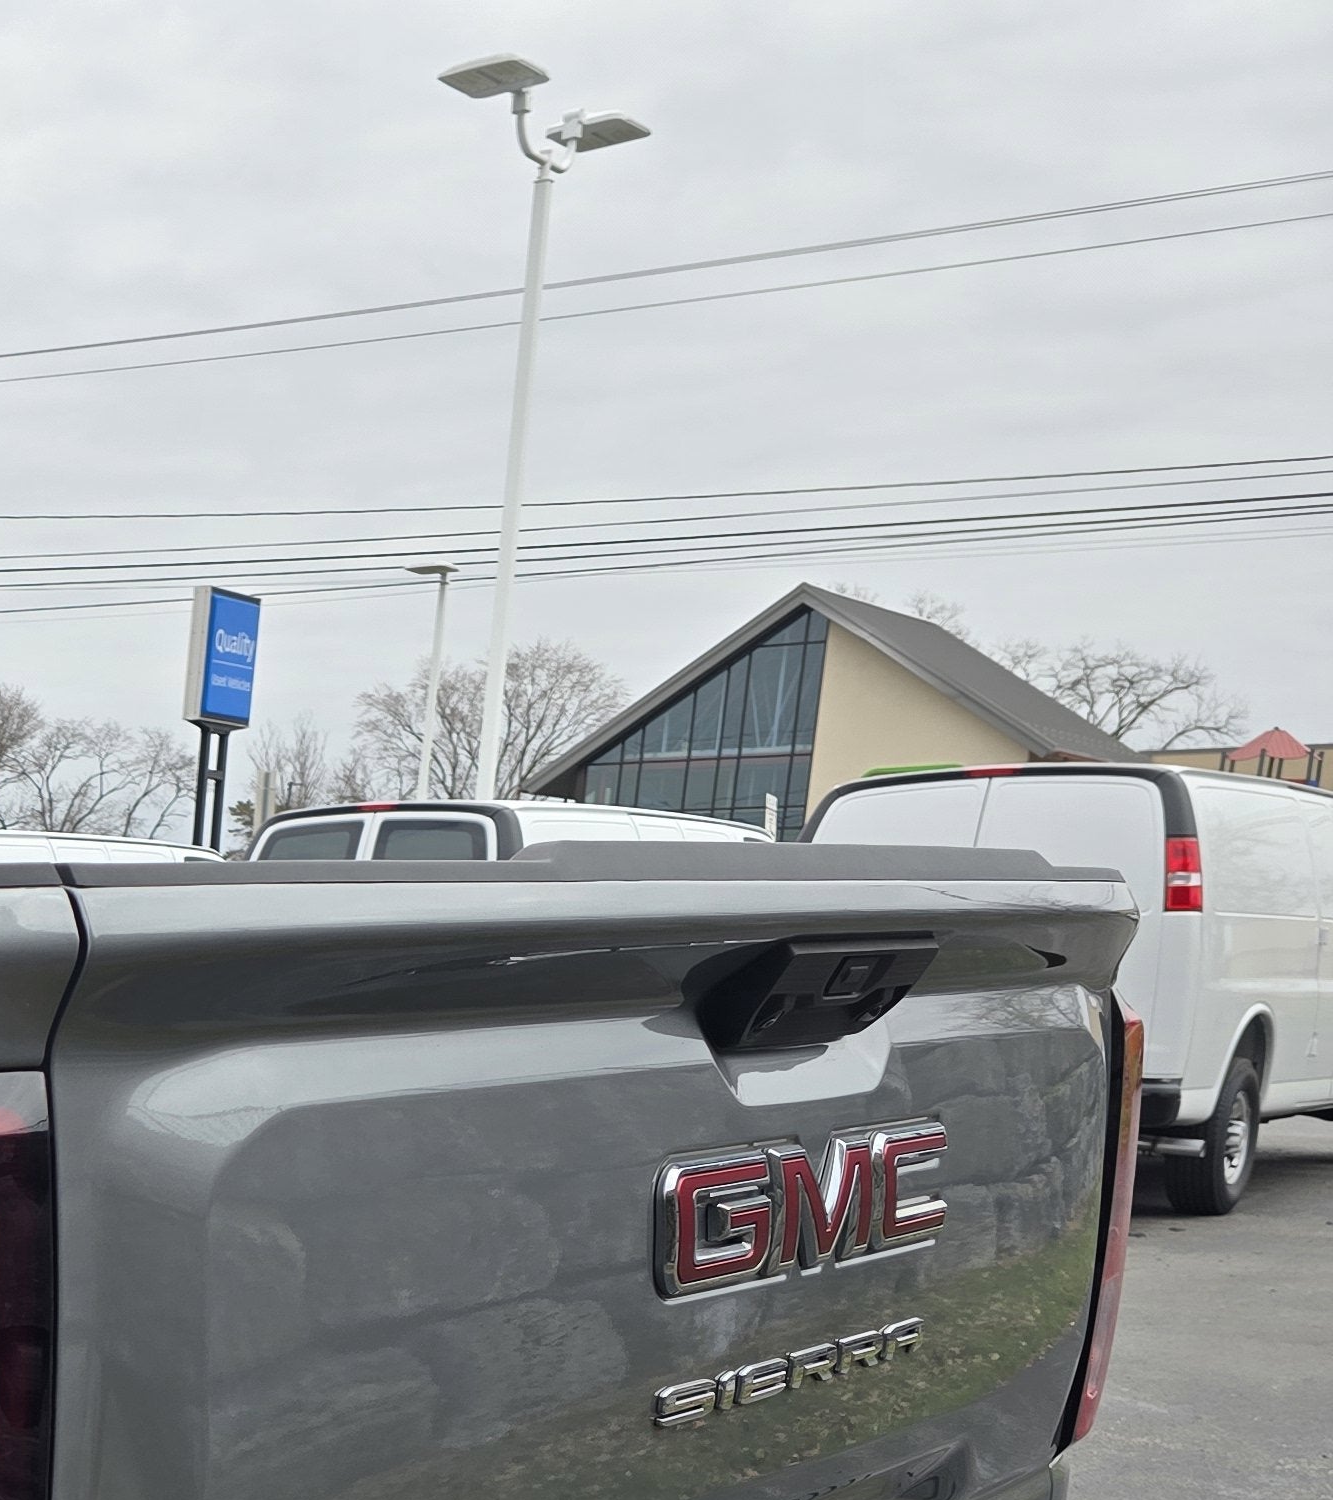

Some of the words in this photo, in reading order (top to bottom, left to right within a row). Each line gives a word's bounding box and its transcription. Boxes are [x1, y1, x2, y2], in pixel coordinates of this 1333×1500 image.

[215, 628, 255, 663] Quality
[653, 1120, 949, 1304] GMC
[653, 1316, 925, 1427] SIERRA
